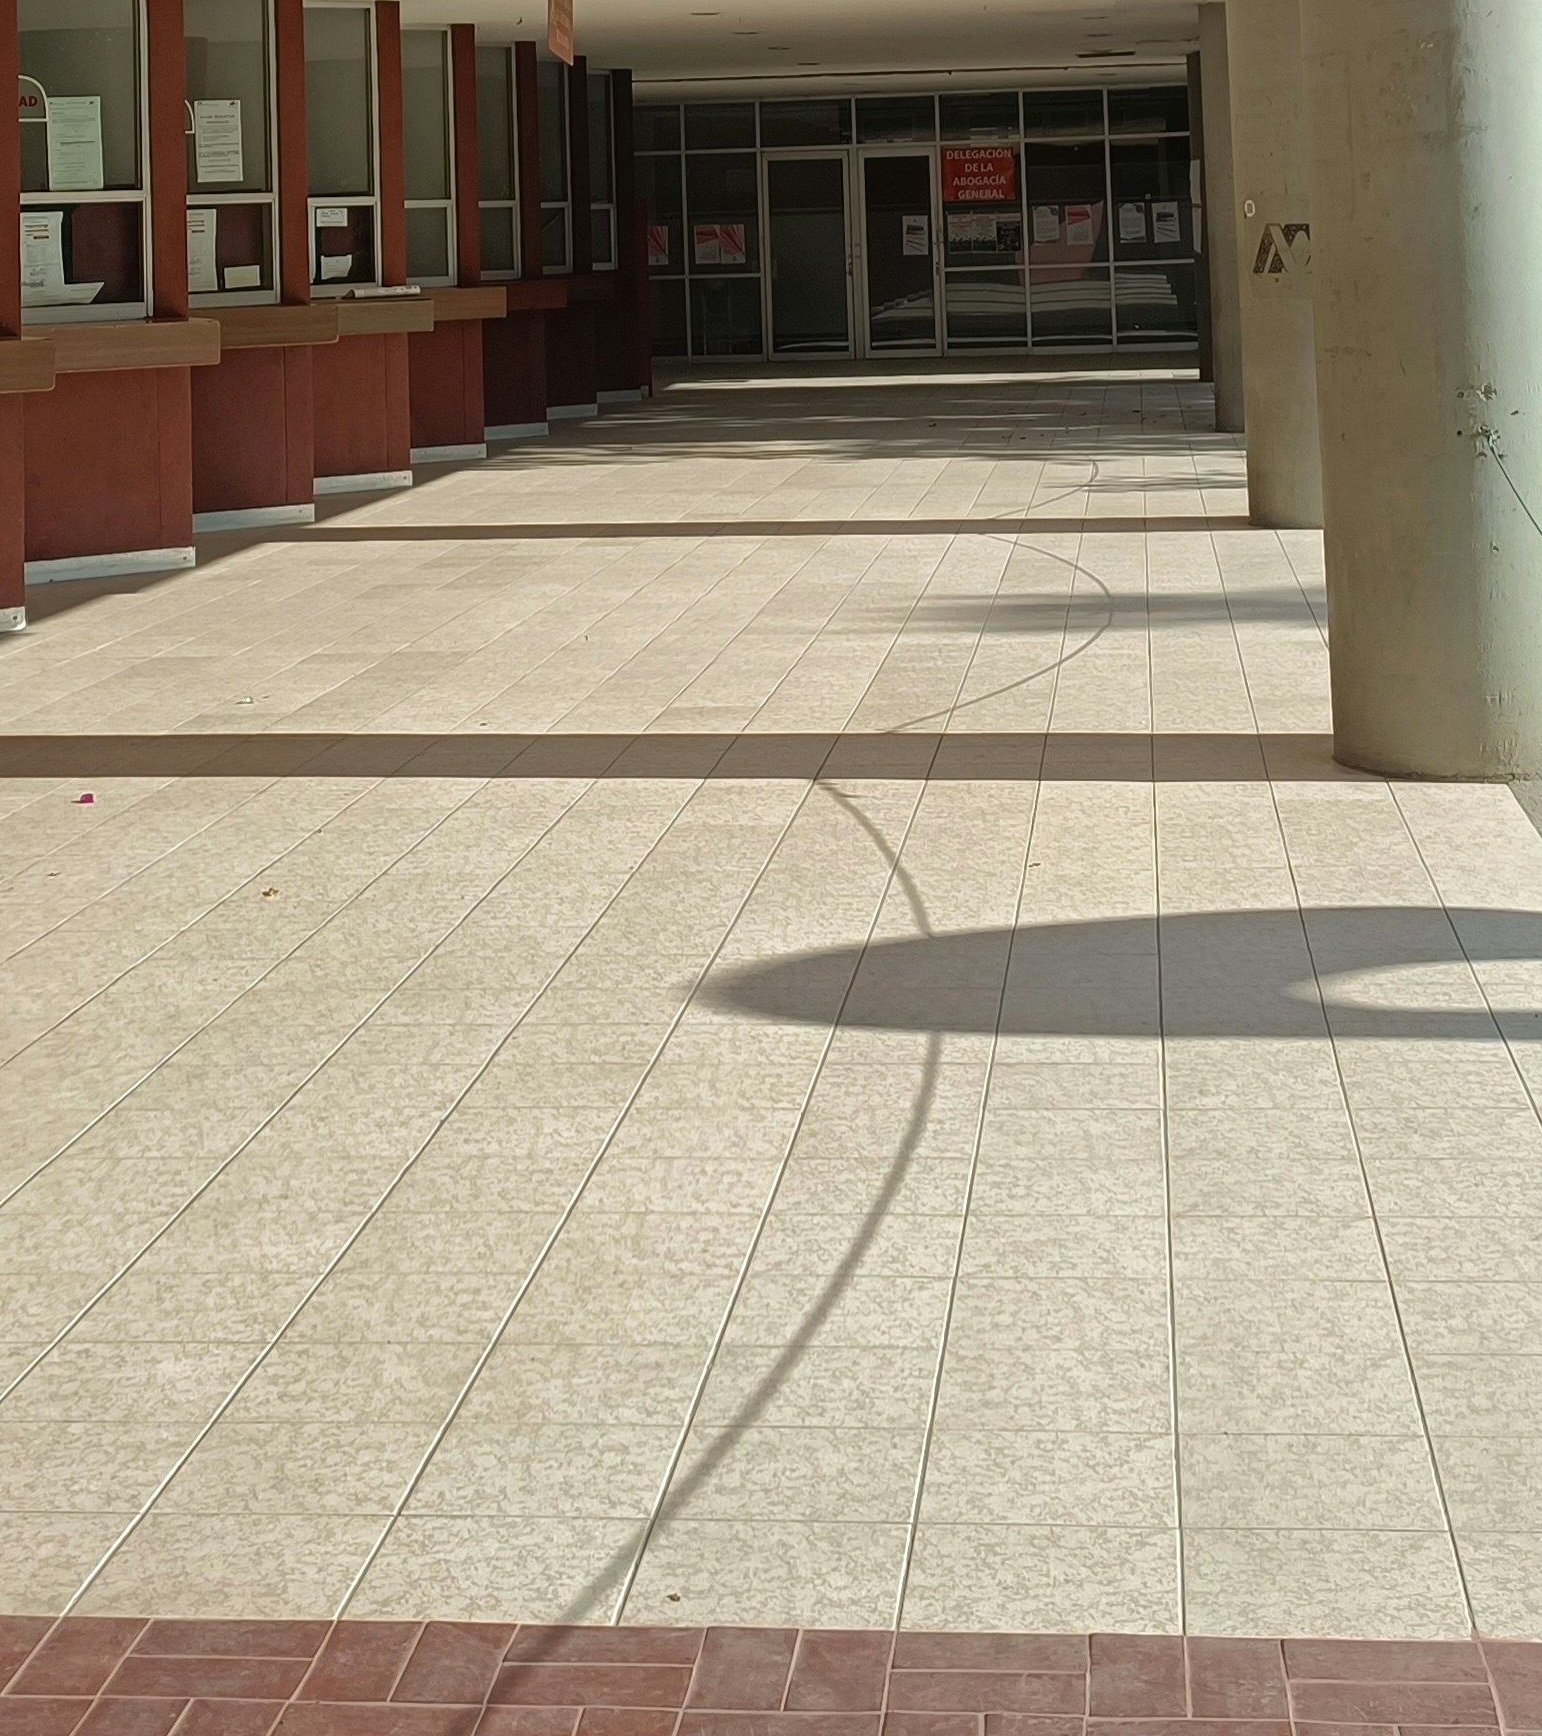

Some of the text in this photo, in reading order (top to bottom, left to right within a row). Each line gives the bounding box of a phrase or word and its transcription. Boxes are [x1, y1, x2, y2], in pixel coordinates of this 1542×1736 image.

[18, 96, 38, 108] AD
[946, 148, 1011, 160] DELEGACIÓN
[964, 162, 994, 172] DE LA
[953, 175, 1006, 186] ABOGACÍA
[958, 189, 1005, 200] GENERAL
